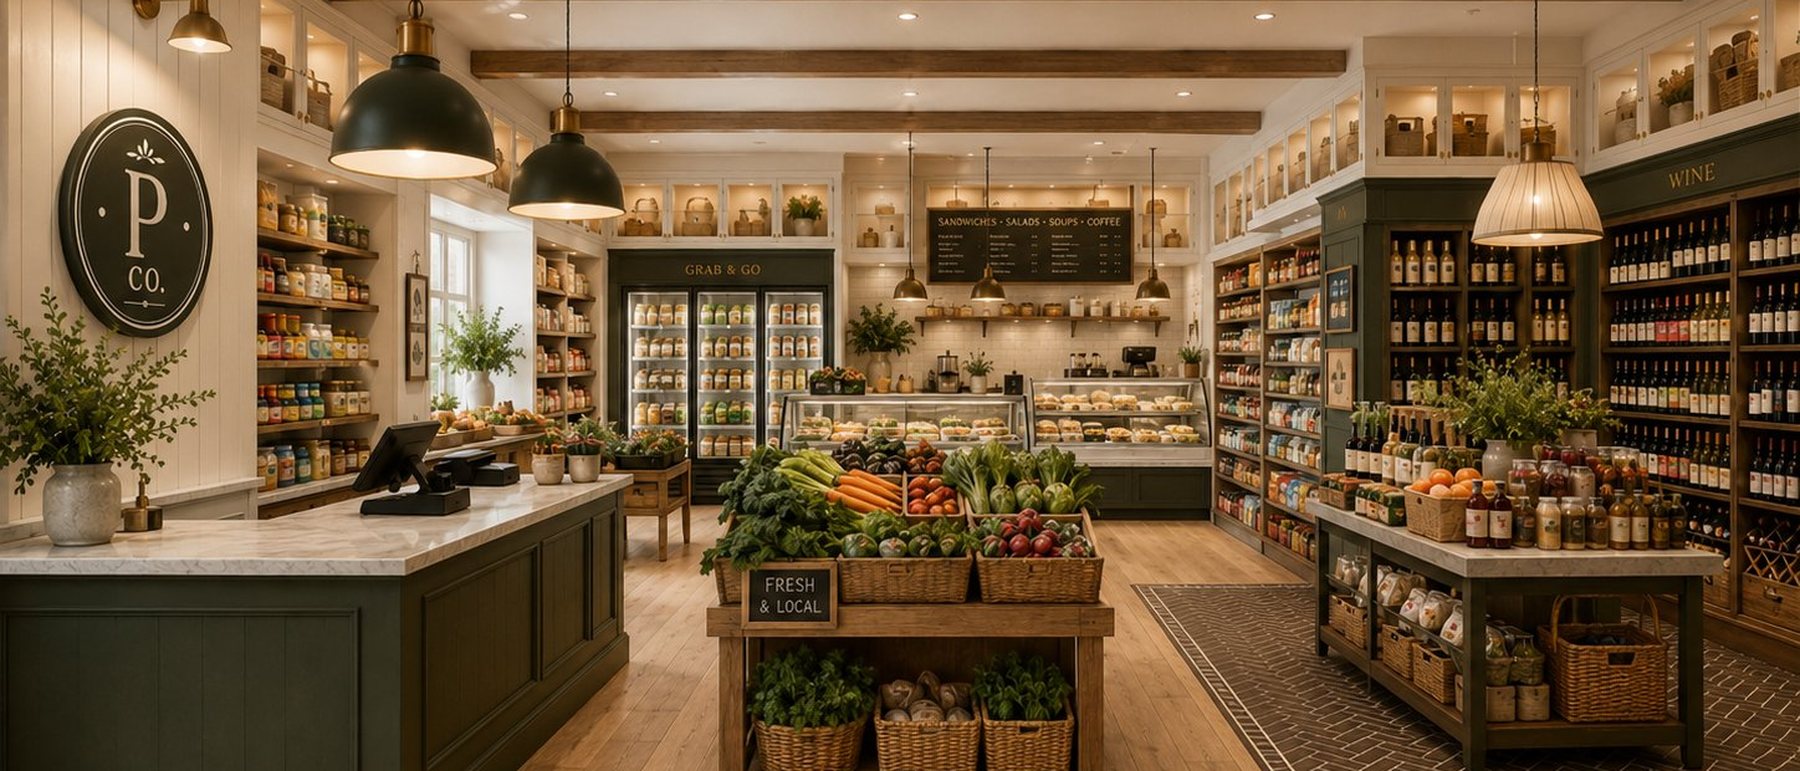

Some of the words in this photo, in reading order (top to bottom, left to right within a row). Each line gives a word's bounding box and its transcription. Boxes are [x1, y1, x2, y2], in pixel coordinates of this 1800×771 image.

[1668, 162, 1715, 189] WINE
[124, 168, 168, 259] P
[937, 217, 997, 227] SANDWICHES
[1005, 217, 1041, 227] SALADS
[1048, 217, 1079, 227] SOUPS
[1086, 217, 1121, 227] COFFEE
[685, 264, 722, 276] GRAB
[726, 264, 736, 276] &
[741, 264, 761, 276] GO
[128, 265, 165, 294] CO.
[765, 577, 815, 593] FRESH
[759, 599, 770, 614] &
[776, 599, 822, 614] LOCAL
